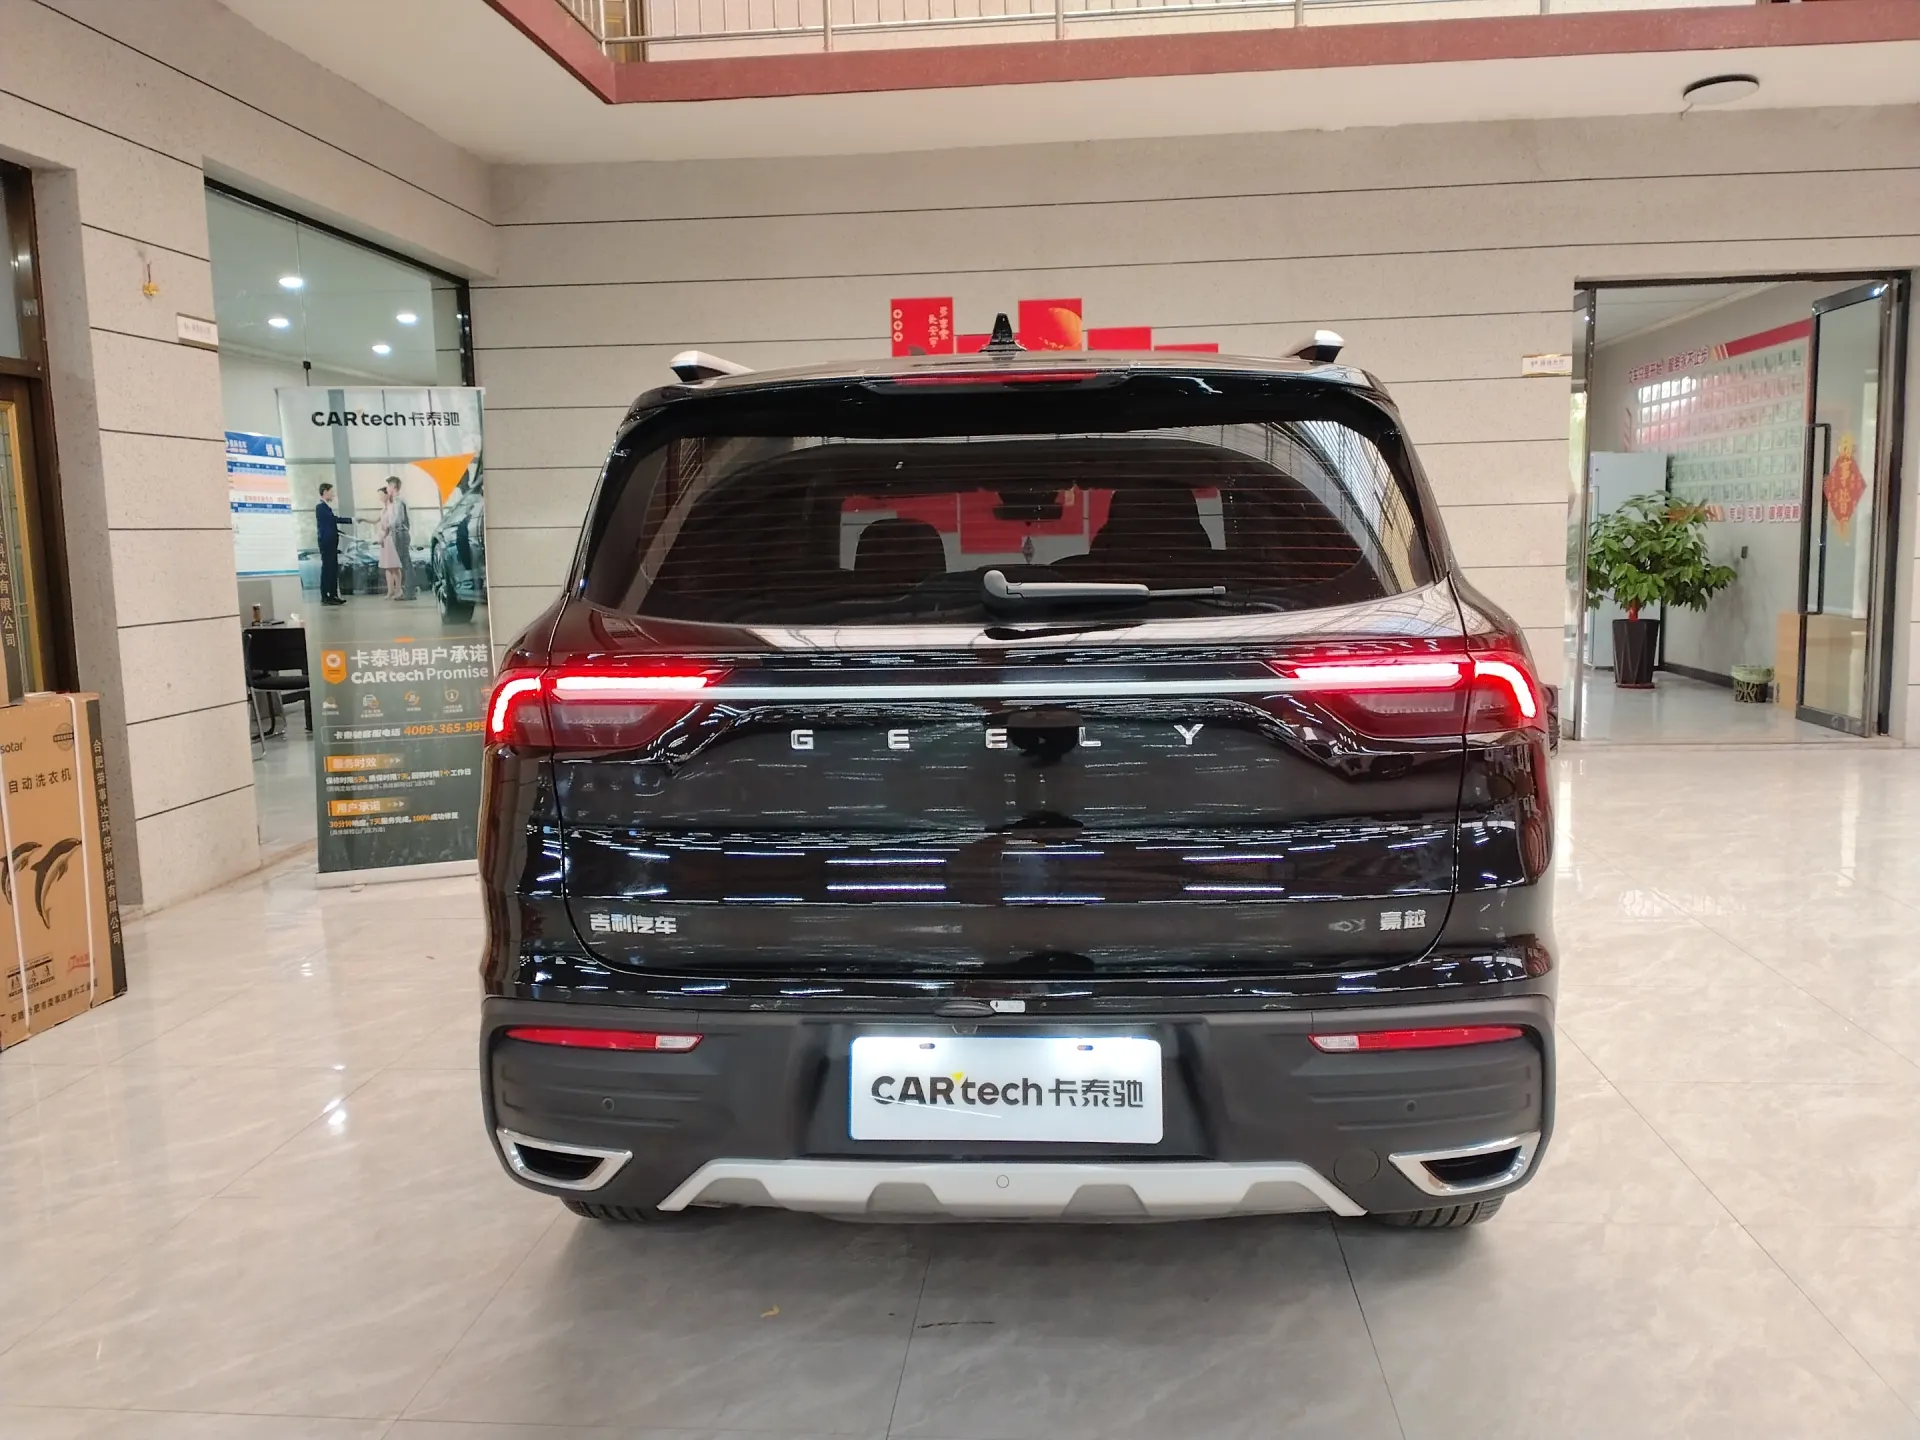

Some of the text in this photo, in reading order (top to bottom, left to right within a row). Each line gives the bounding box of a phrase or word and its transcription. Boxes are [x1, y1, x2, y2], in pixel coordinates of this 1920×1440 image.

[408, 411, 460, 427] 卡泰驰
[350, 644, 488, 669] 卡泰驰用户承诺
[351, 669, 424, 685] CARtech
[426, 665, 489, 681] Promise
[790, 724, 1204, 750] GEELY
[8, 768, 72, 794] 自动洗衣机
[590, 913, 677, 935] 吉利汽车
[1380, 909, 1427, 931] 豪越
[871, 1075, 1144, 1108] CARtech 卡泰驰
